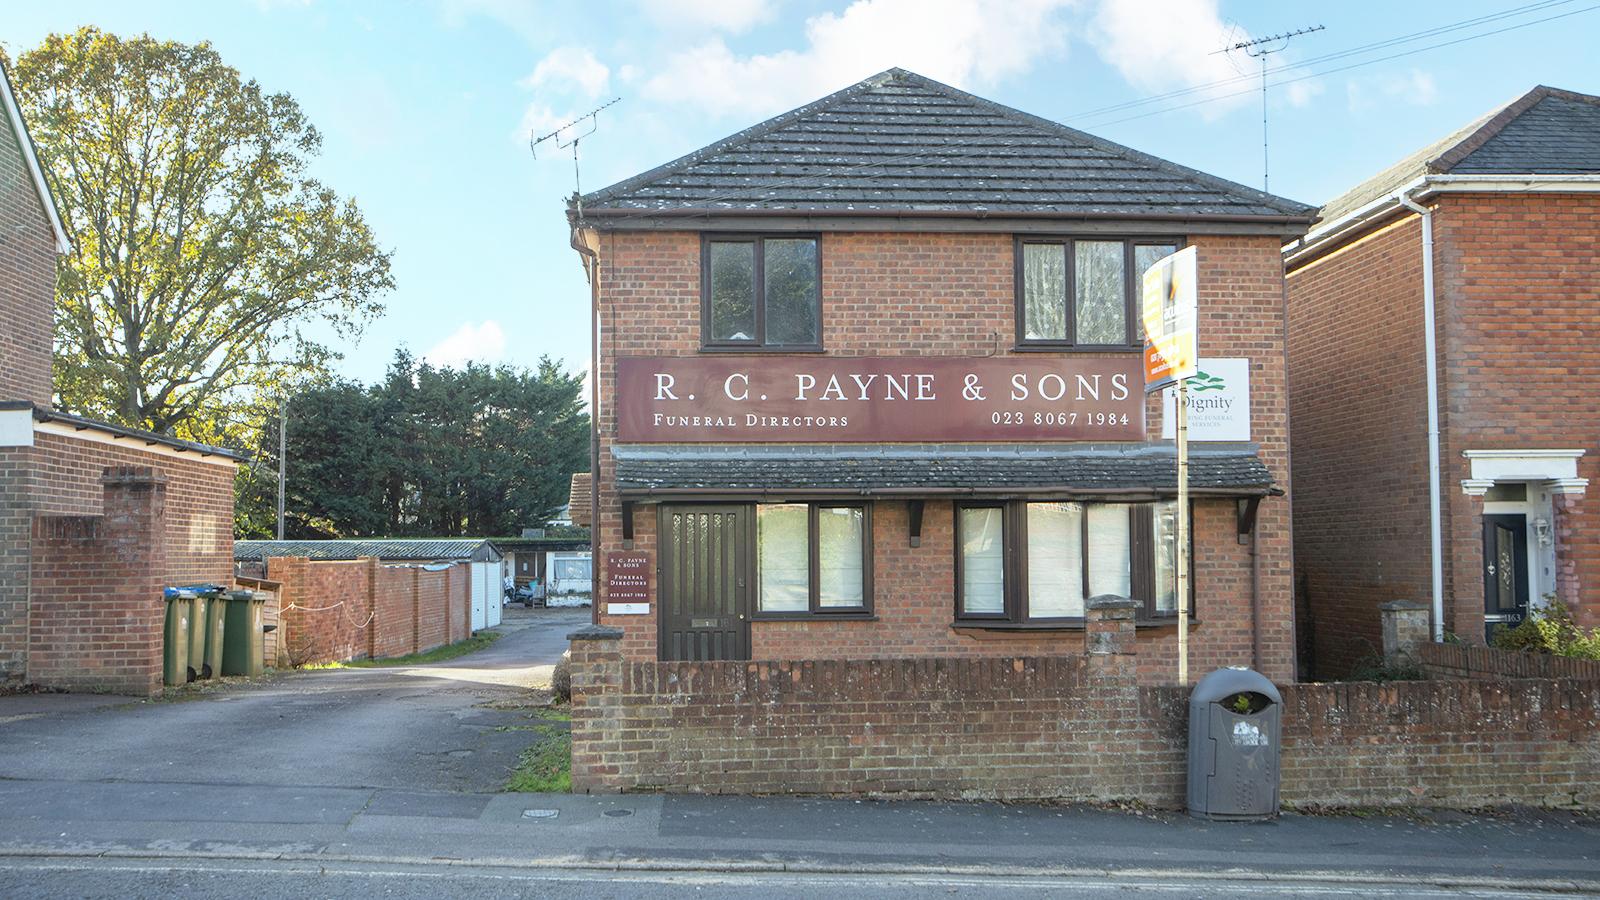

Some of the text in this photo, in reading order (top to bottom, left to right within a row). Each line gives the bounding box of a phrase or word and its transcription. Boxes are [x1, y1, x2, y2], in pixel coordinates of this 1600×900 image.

[653, 373, 1129, 401] R. C. PAYNE & SONS
[653, 413, 849, 427] FUNERAL DIRECTORS
[991, 411, 1129, 426] 023 8067 1984
